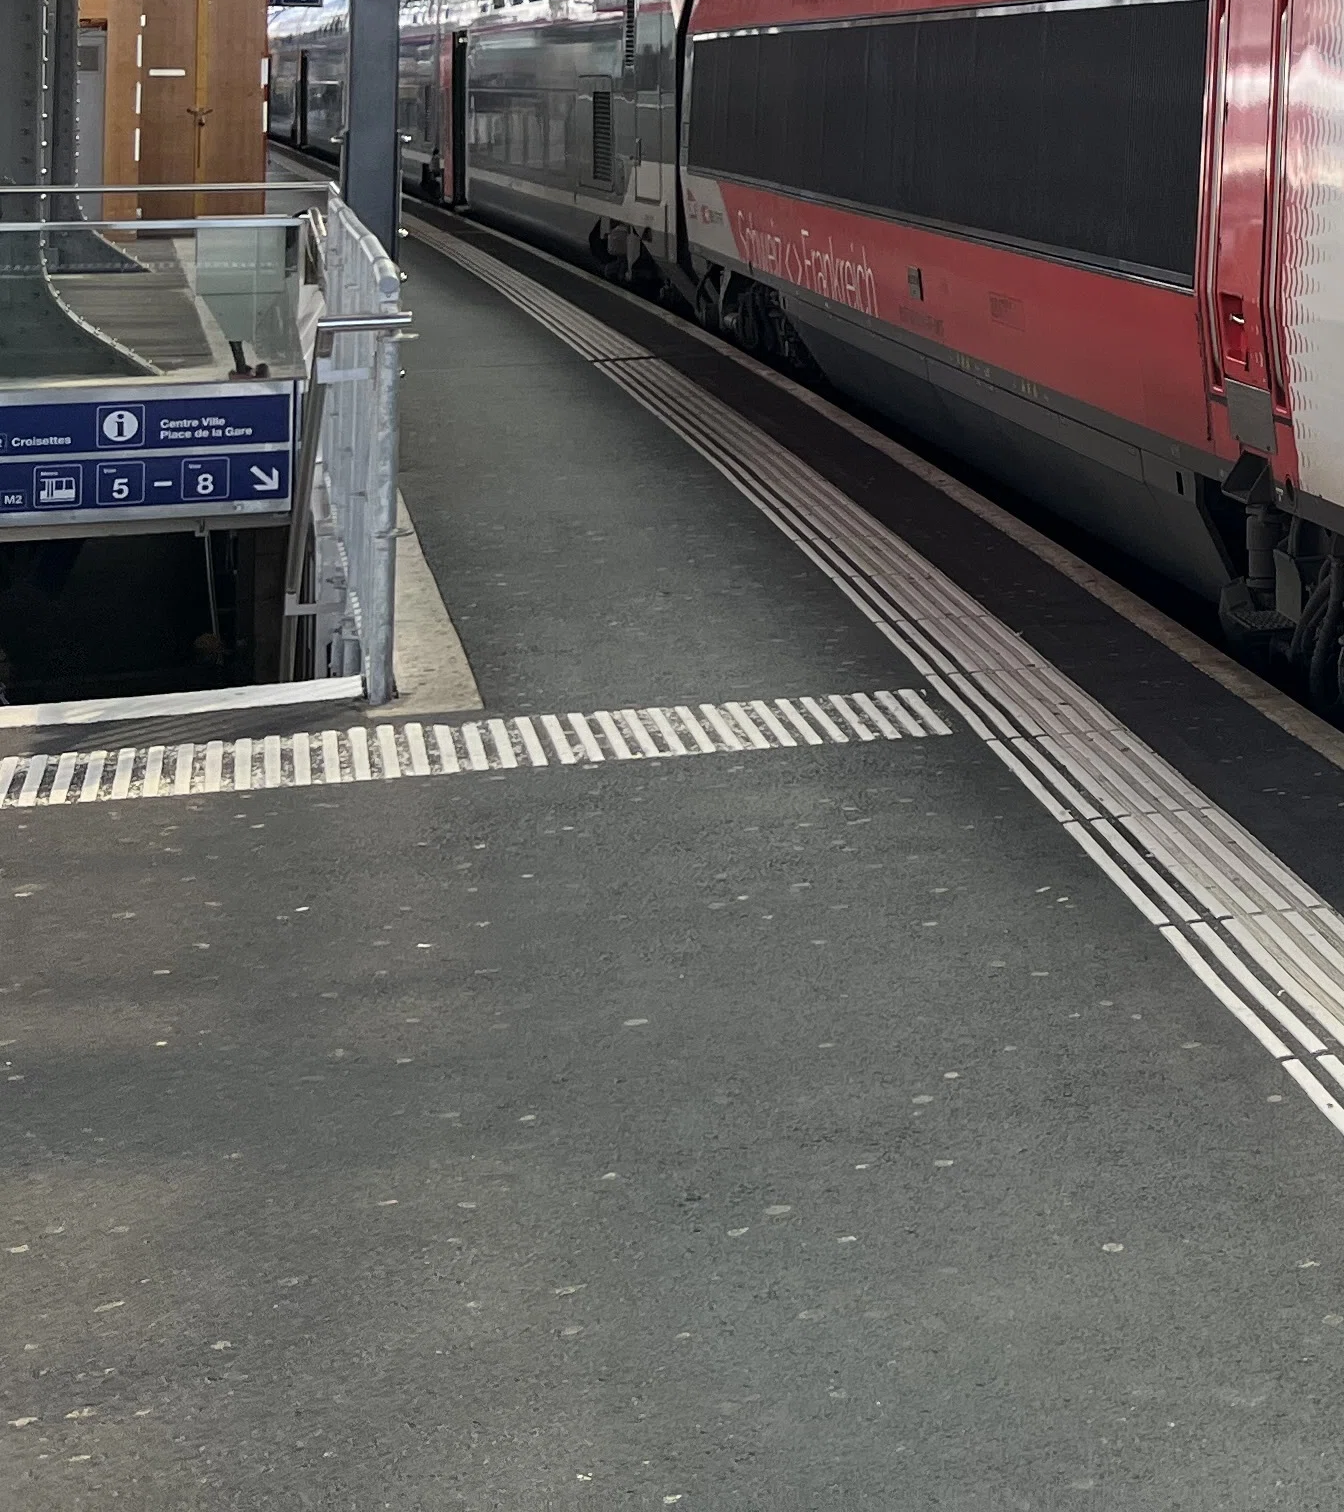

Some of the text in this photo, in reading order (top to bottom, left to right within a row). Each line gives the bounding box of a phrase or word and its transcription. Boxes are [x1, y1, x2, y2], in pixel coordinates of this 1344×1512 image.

[801, 228, 880, 319] Frankreich
[160, 417, 226, 429] Centre Ville
[160, 426, 253, 440] Place de la Gare
[11, 436, 72, 447] Croisettes
[112, 478, 129, 499] 5
[197, 473, 214, 494] 8
[4, 494, 23, 505] M2
